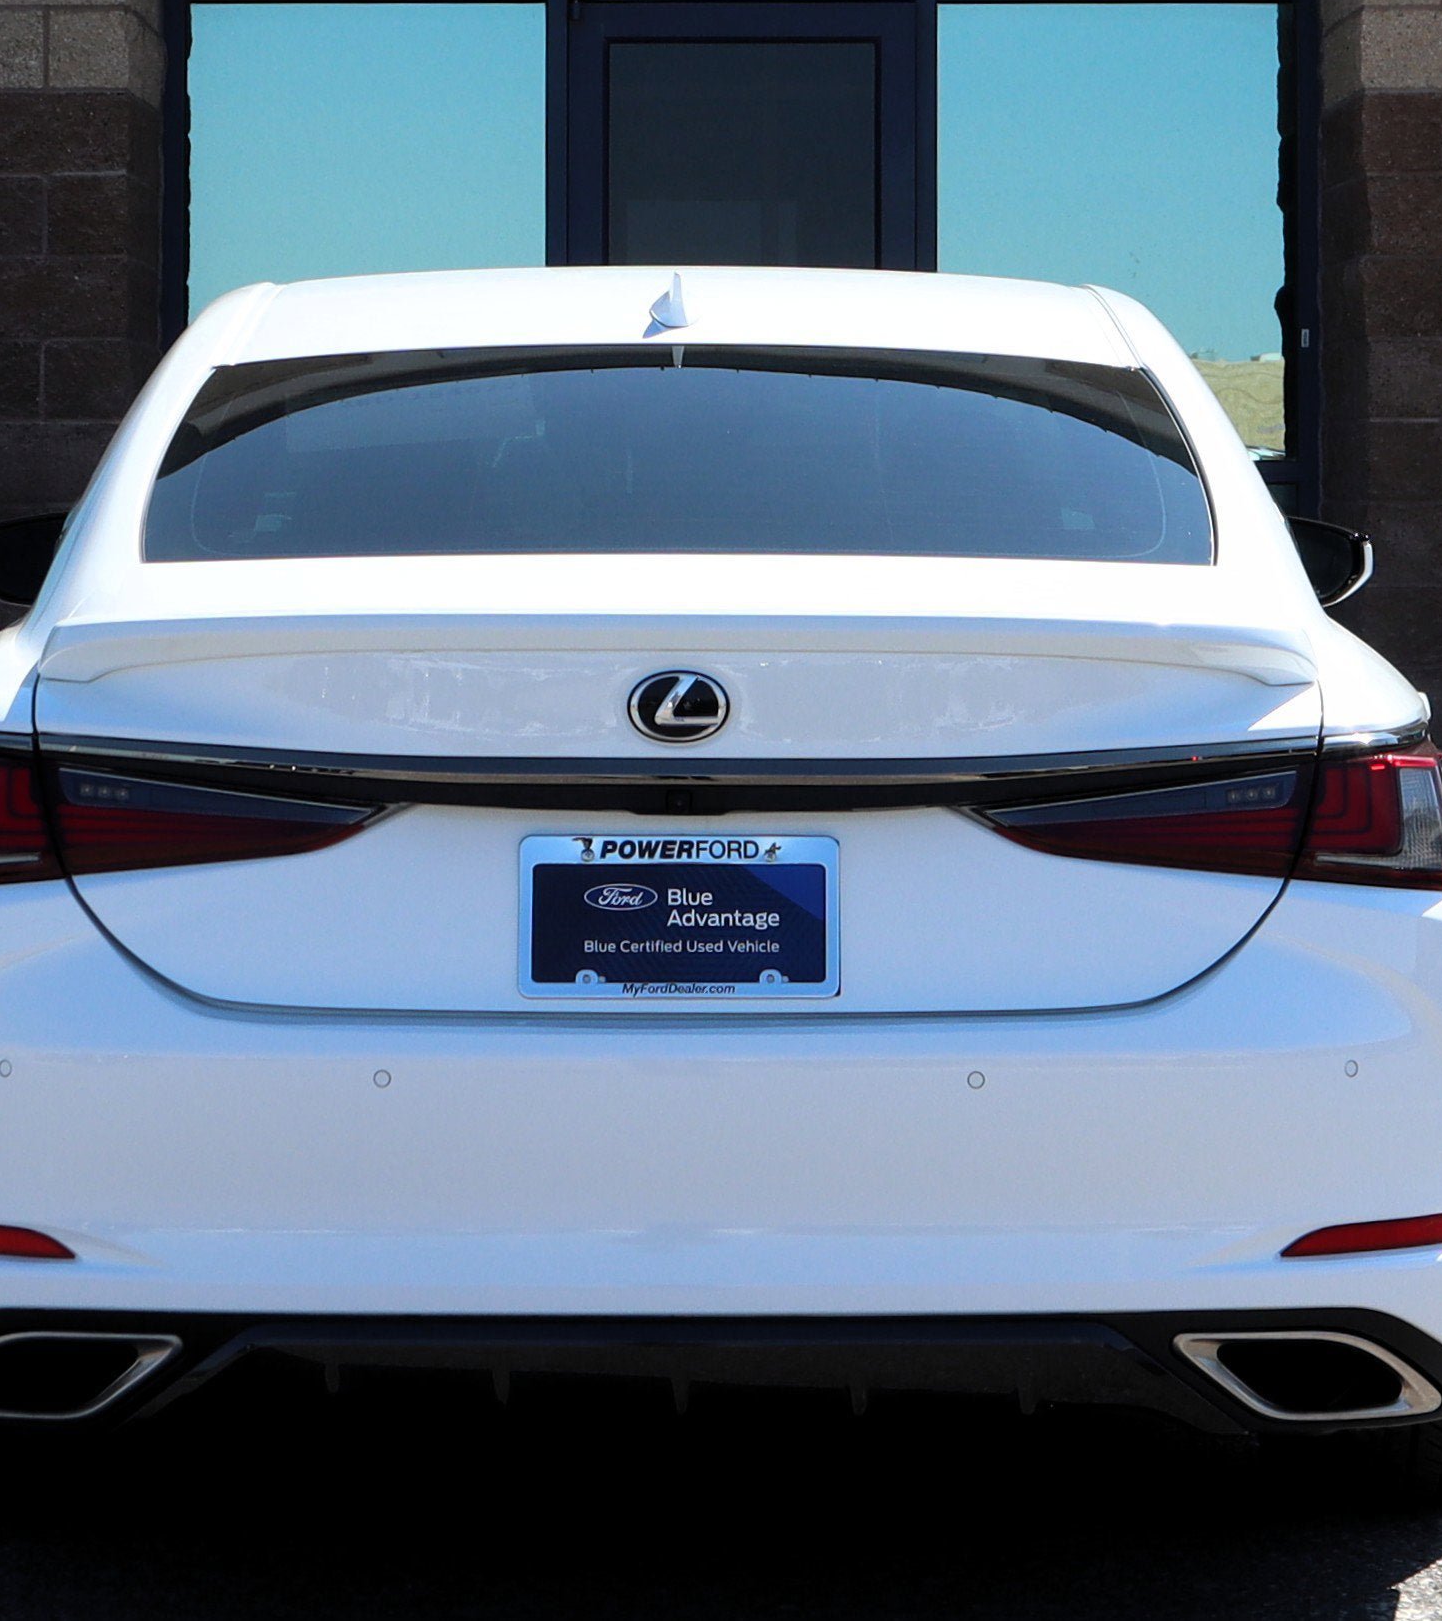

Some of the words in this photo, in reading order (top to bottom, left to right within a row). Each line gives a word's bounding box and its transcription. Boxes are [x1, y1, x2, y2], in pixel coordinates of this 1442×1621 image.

[597, 886, 645, 908] Ford
[666, 888, 714, 906] Blue
[666, 909, 781, 930] Advantage
[583, 940, 617, 954] Blue
[619, 940, 683, 954] Certified
[685, 940, 724, 954] Used
[726, 940, 781, 954] Vehicle
[621, 982, 737, 998] MyFordDealer.com
